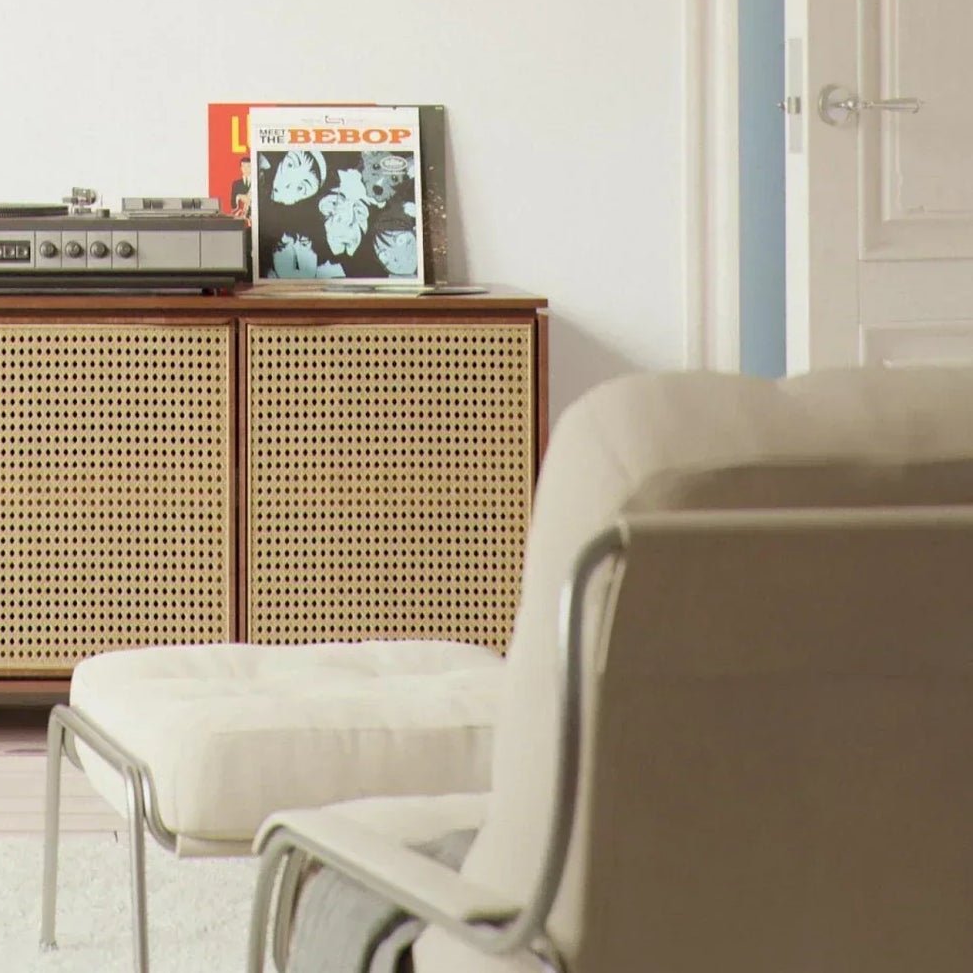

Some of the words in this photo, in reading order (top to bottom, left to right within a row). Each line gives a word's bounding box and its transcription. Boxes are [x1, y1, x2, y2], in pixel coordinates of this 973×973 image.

[231, 114, 251, 153] L
[259, 128, 286, 136] MEET
[287, 128, 412, 144] BEBOP
[259, 136, 285, 144] THE
